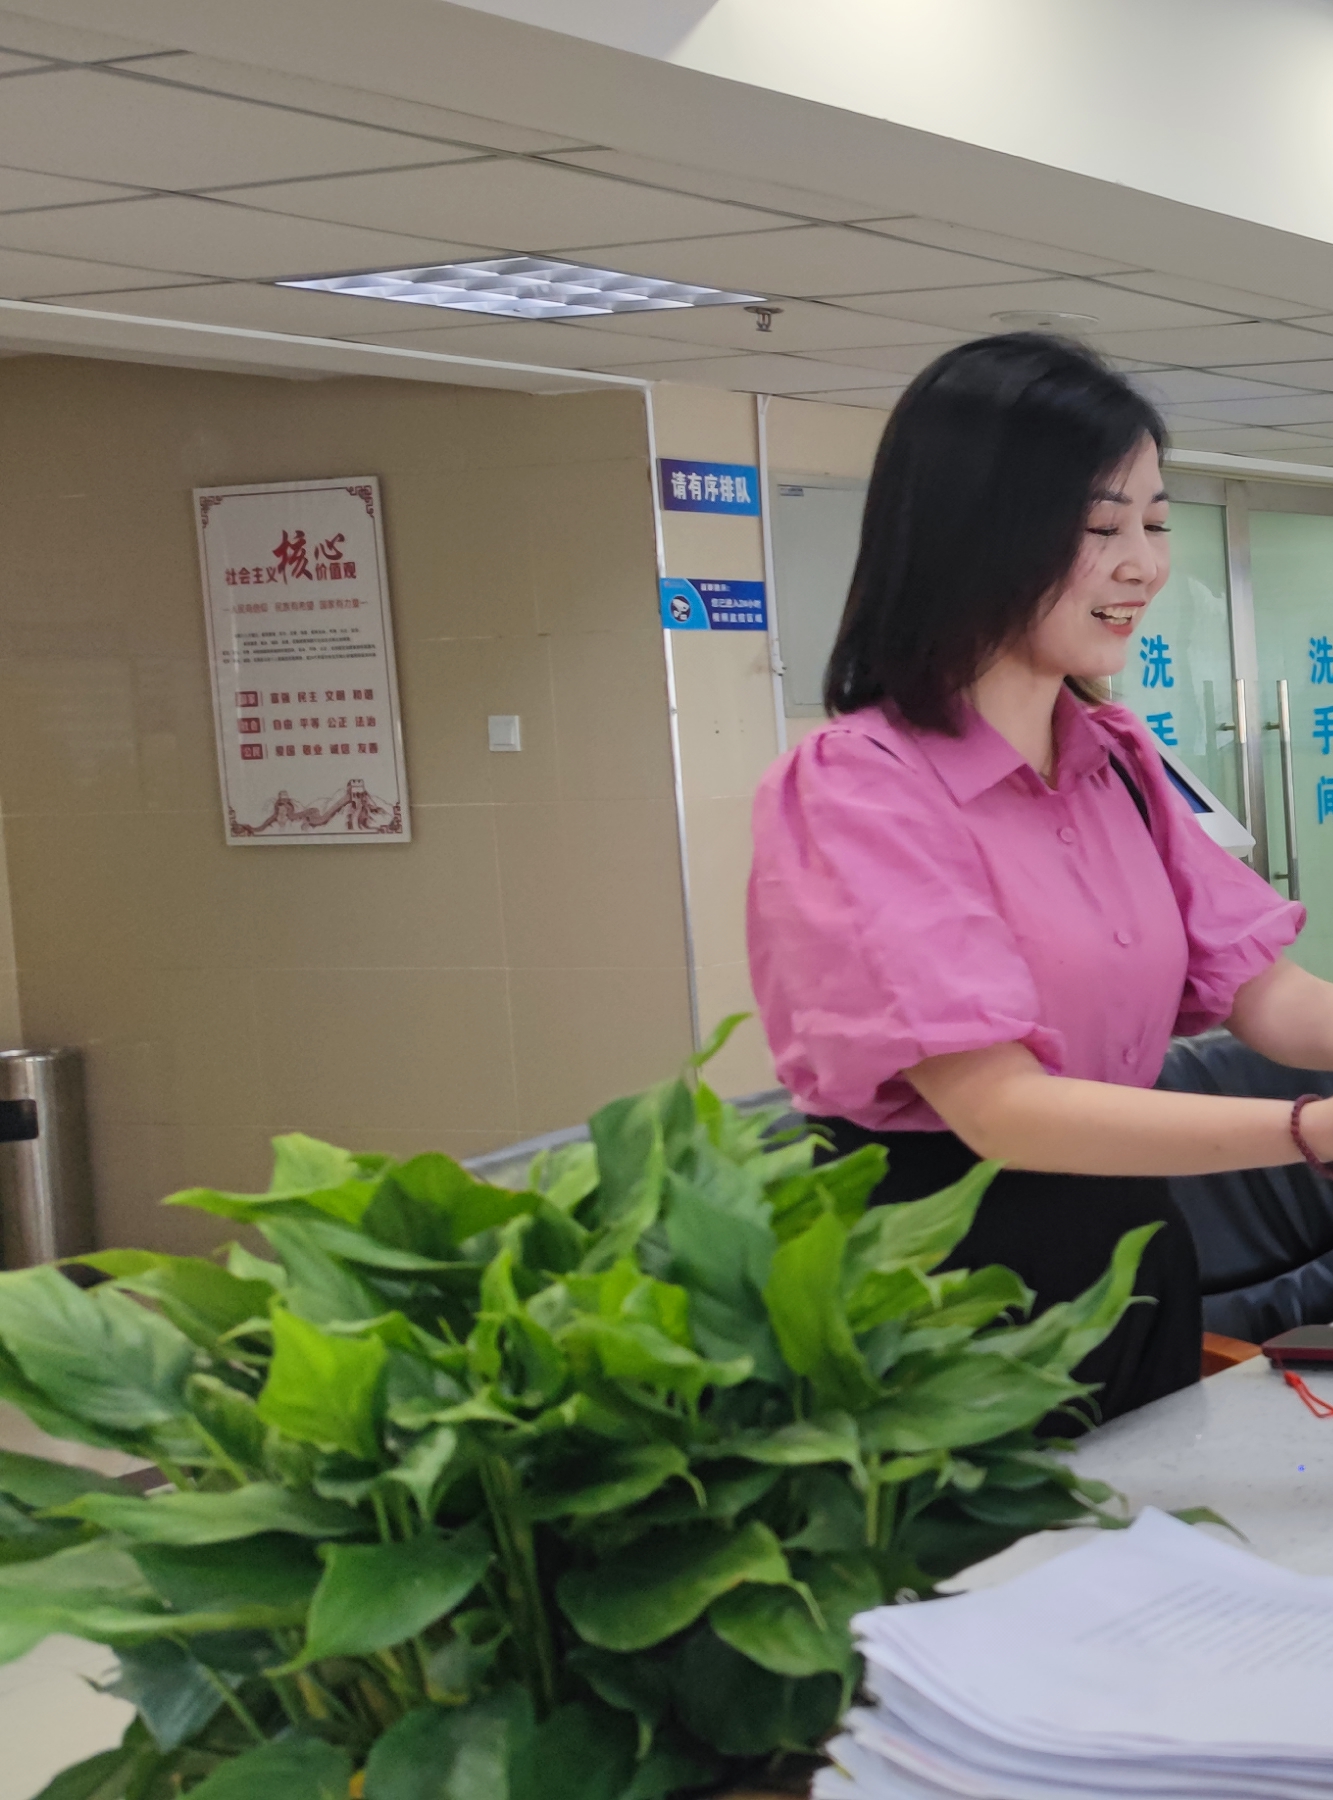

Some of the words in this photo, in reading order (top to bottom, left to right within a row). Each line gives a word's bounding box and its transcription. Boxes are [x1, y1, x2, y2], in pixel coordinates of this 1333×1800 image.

[671, 471, 751, 503] 请有序排队
[225, 565, 278, 586] 社会主义
[272, 529, 346, 585] 核心
[315, 561, 357, 582] 价值观
[297, 691, 318, 703] 民主
[327, 716, 347, 728] 公正
